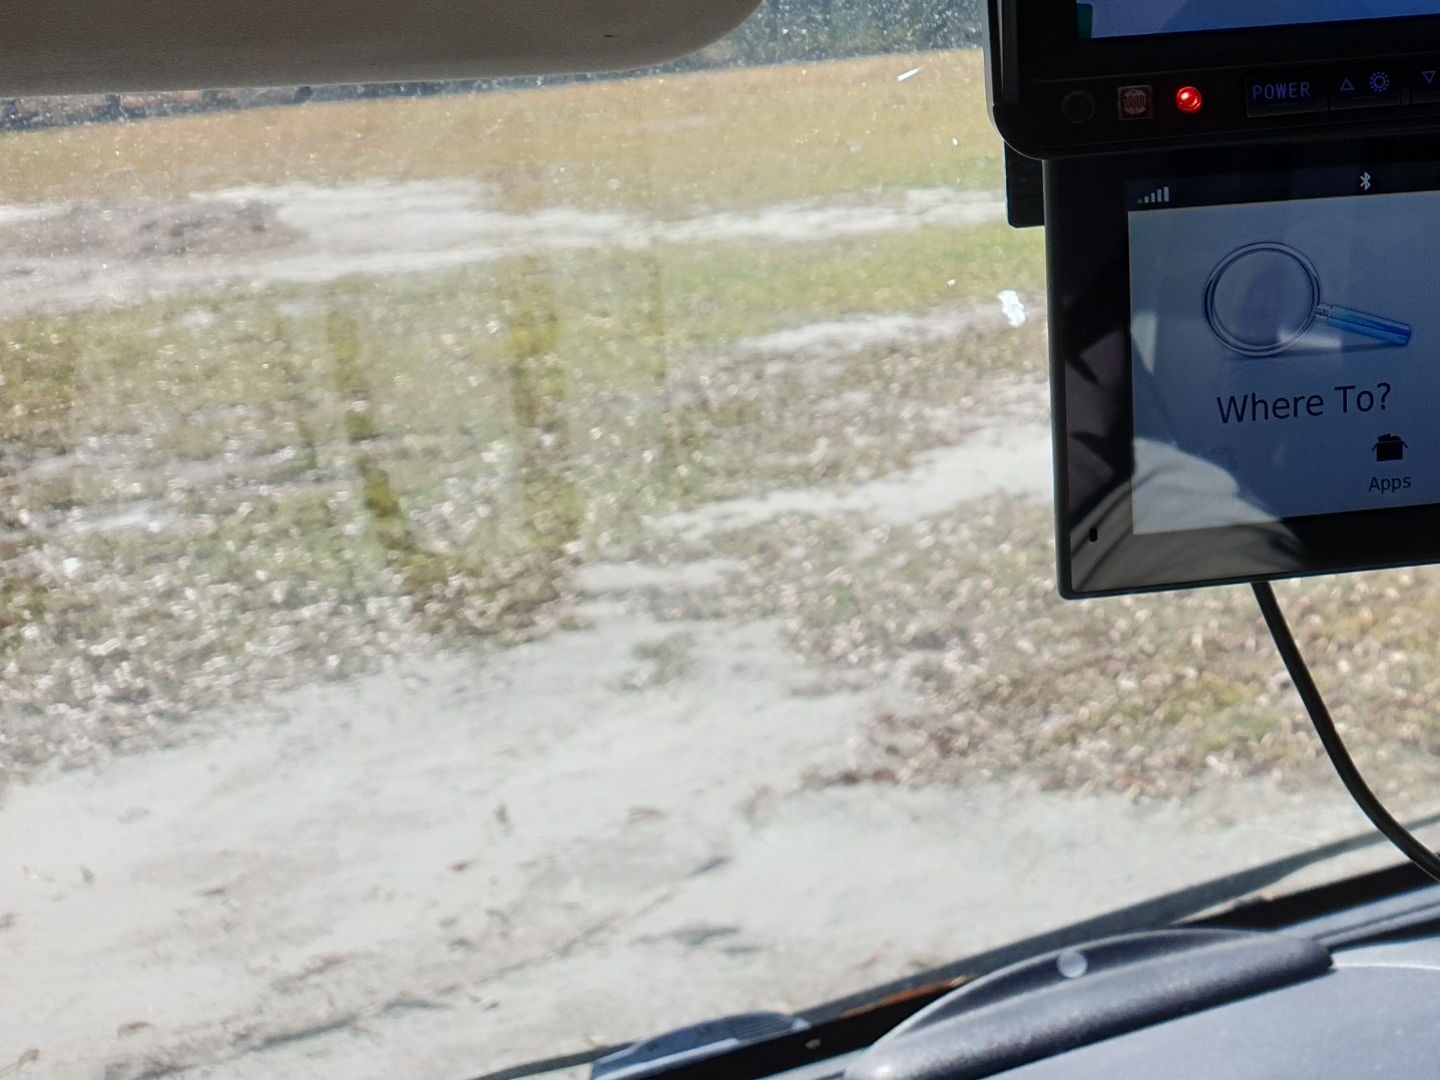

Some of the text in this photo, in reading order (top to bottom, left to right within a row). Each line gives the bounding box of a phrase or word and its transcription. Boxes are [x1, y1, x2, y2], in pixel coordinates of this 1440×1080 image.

[1252, 81, 1311, 100] POWER
[1216, 382, 1392, 424] Where To?
[1368, 475, 1412, 495] Apps
